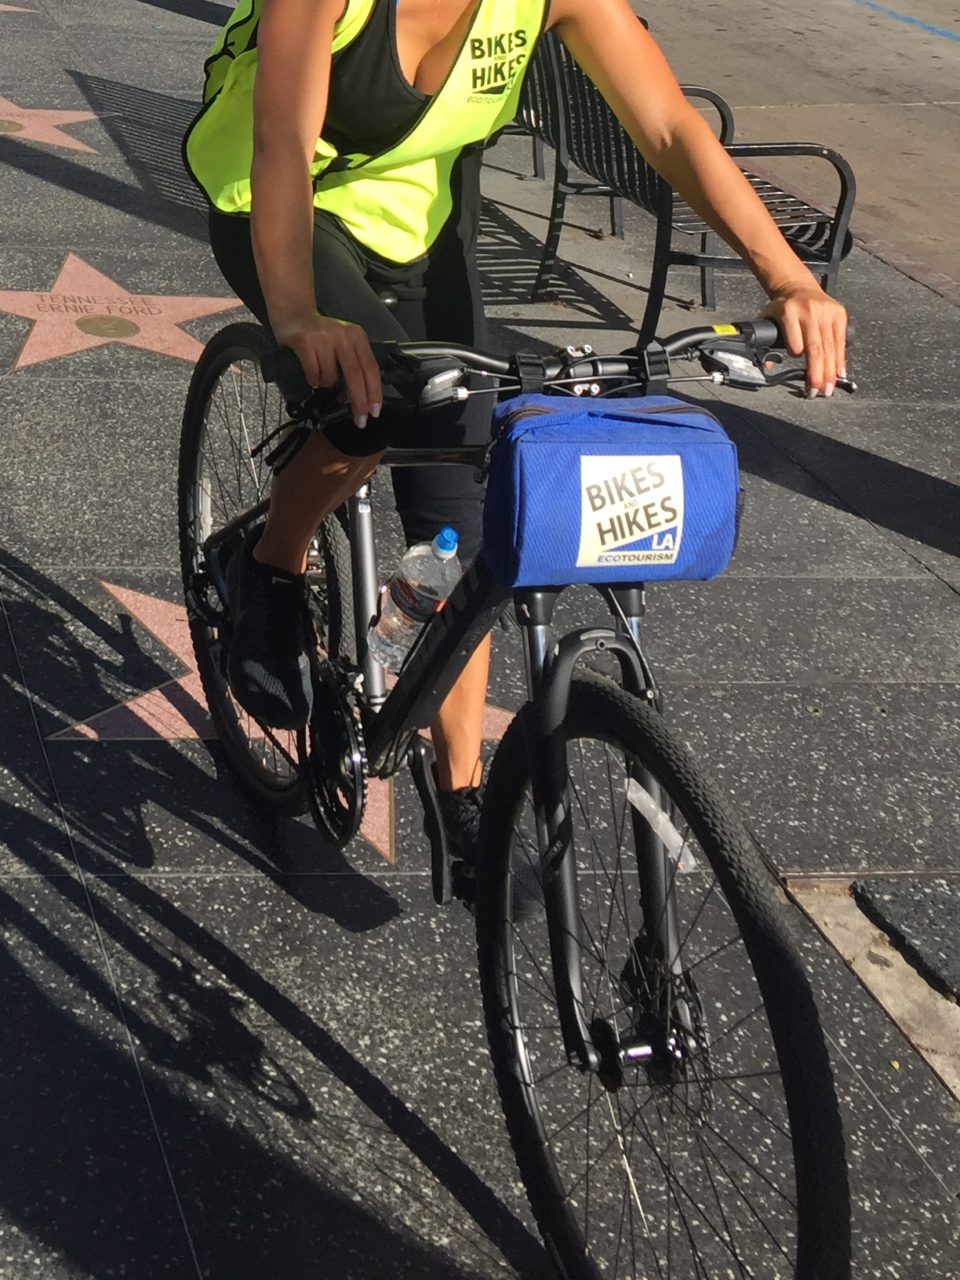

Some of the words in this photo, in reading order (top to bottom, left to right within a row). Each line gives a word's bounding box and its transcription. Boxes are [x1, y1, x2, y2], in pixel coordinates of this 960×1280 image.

[470, 29, 528, 60] BIKES
[34, 293, 156, 307] TENNESSEE
[35, 303, 96, 315] ERNIE
[105, 305, 163, 316] FORD
[586, 462, 666, 513] BIKES
[624, 499, 639, 510] AND
[596, 496, 679, 547] HIKES
[652, 533, 675, 551] LA
[596, 552, 675, 564] ECOTOURISM
